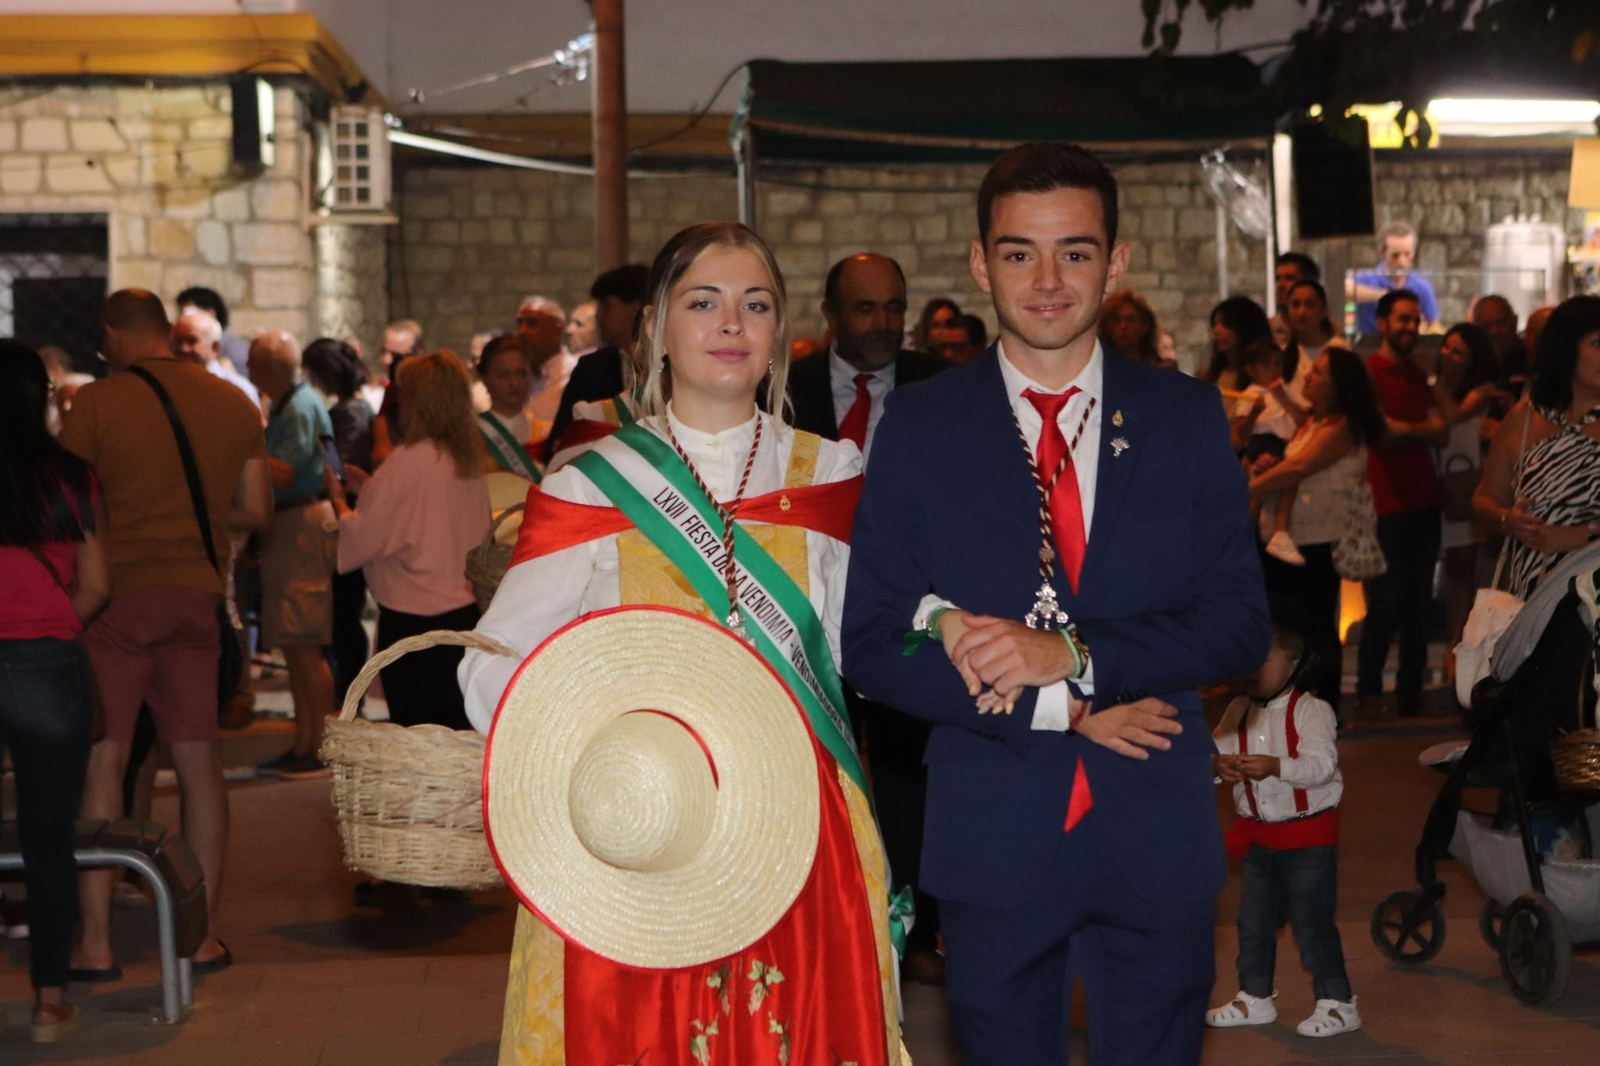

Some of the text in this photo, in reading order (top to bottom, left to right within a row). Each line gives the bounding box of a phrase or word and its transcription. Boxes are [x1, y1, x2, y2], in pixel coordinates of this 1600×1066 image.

[653, 486, 689, 520] LXVII
[680, 514, 721, 558] FIESTA
[739, 582, 794, 644] VENDIMIA
